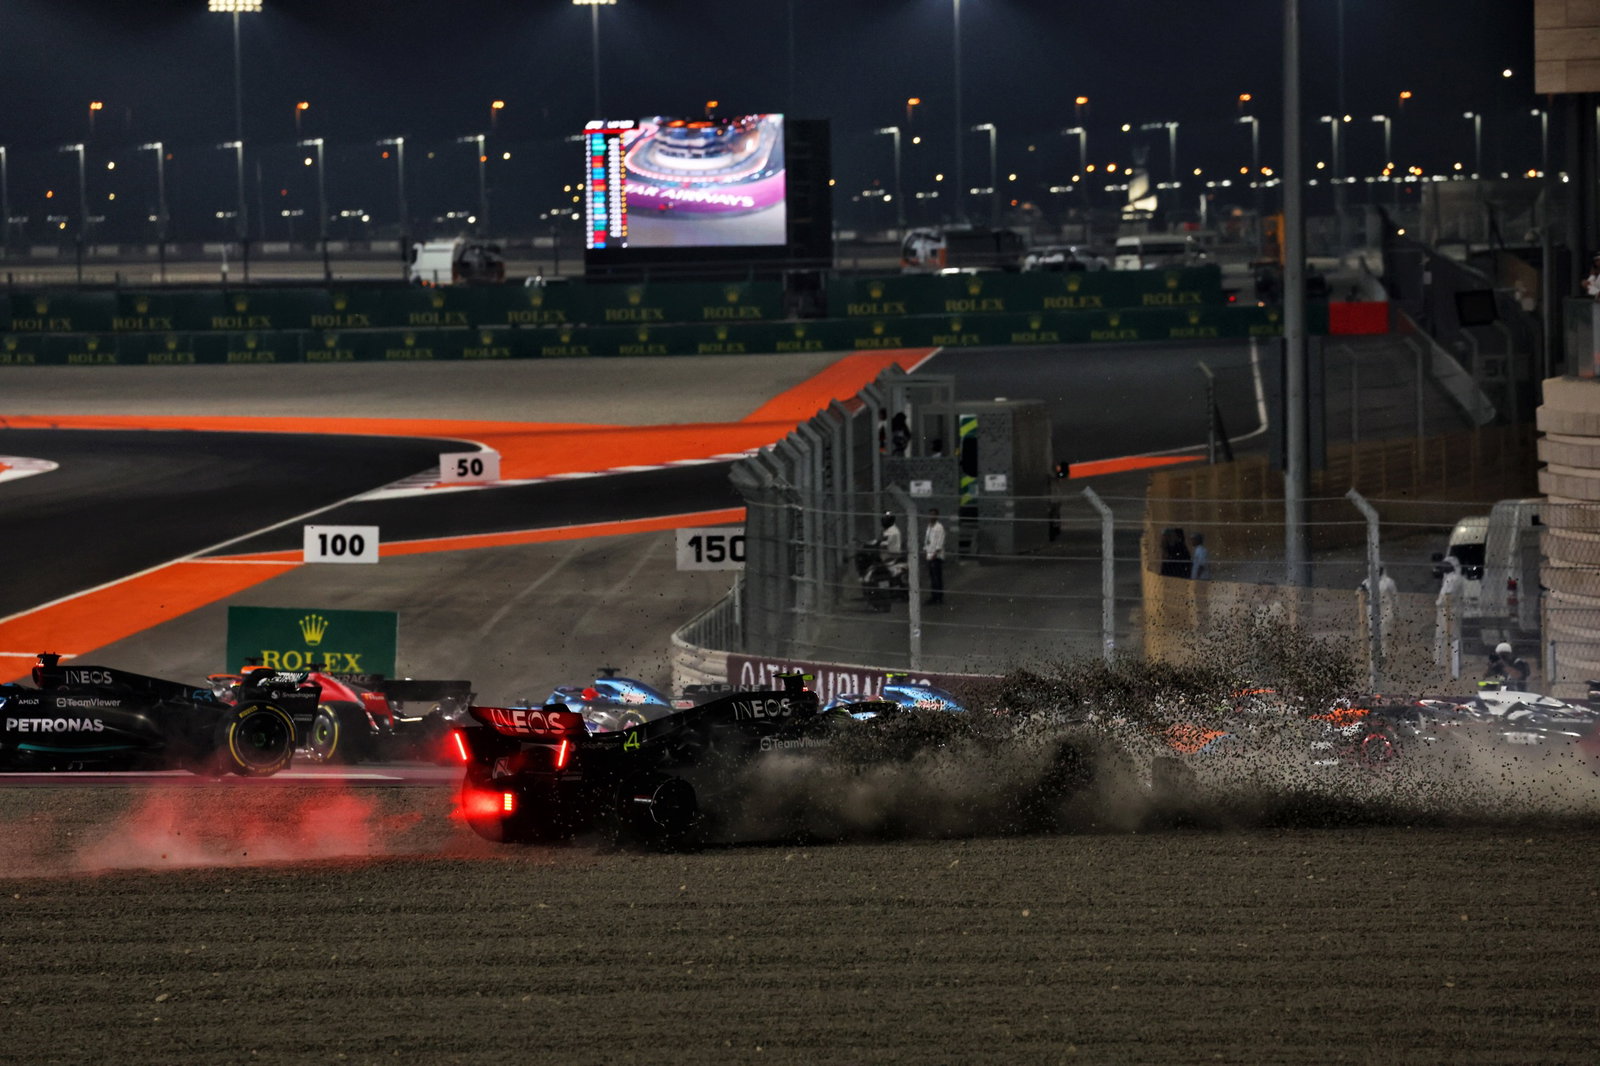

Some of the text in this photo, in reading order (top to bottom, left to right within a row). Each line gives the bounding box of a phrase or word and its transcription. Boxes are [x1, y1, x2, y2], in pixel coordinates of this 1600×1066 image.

[1044, 296, 1102, 309] ROLEX
[1143, 293, 1201, 305] ROLEX
[848, 303, 906, 315] ROLEX
[945, 300, 1004, 312] ROLEX
[410, 312, 468, 325] ROLEX
[508, 310, 566, 323] ROLEX
[606, 308, 664, 321] ROLEX
[704, 306, 762, 319] ROLEX
[12, 318, 71, 331] ROLEX
[112, 318, 171, 330] ROLEX
[212, 316, 271, 329] ROLEX
[311, 314, 370, 328] ROLEX
[932, 333, 980, 345] ROLEX
[1011, 331, 1059, 342] ROLEX
[1091, 329, 1138, 340] ROLEX
[698, 341, 746, 353] ROLEX
[776, 339, 824, 351] ROLEX
[855, 336, 902, 348] ROLEX
[386, 347, 434, 359] ROLEX
[463, 346, 510, 357] ROLEX
[542, 345, 590, 356] ROLEX
[619, 343, 668, 354] ROLEX
[68, 352, 117, 363] ROLEX
[148, 351, 196, 362] ROLEX
[227, 350, 275, 362] ROLEX
[306, 349, 355, 361] ROLEX
[457, 459, 483, 476] 50
[318, 534, 364, 556] 100
[688, 535, 746, 563] 150
[261, 650, 363, 673] ROLEX
[65, 670, 113, 685] INEOS
[699, 685, 761, 693] ALPINE
[68, 698, 121, 707] TeamViewer
[732, 698, 792, 721] INEOS
[6, 718, 105, 733] PETRONAS
[490, 709, 566, 734] INEOS
[773, 736, 831, 749] TeamViewer
